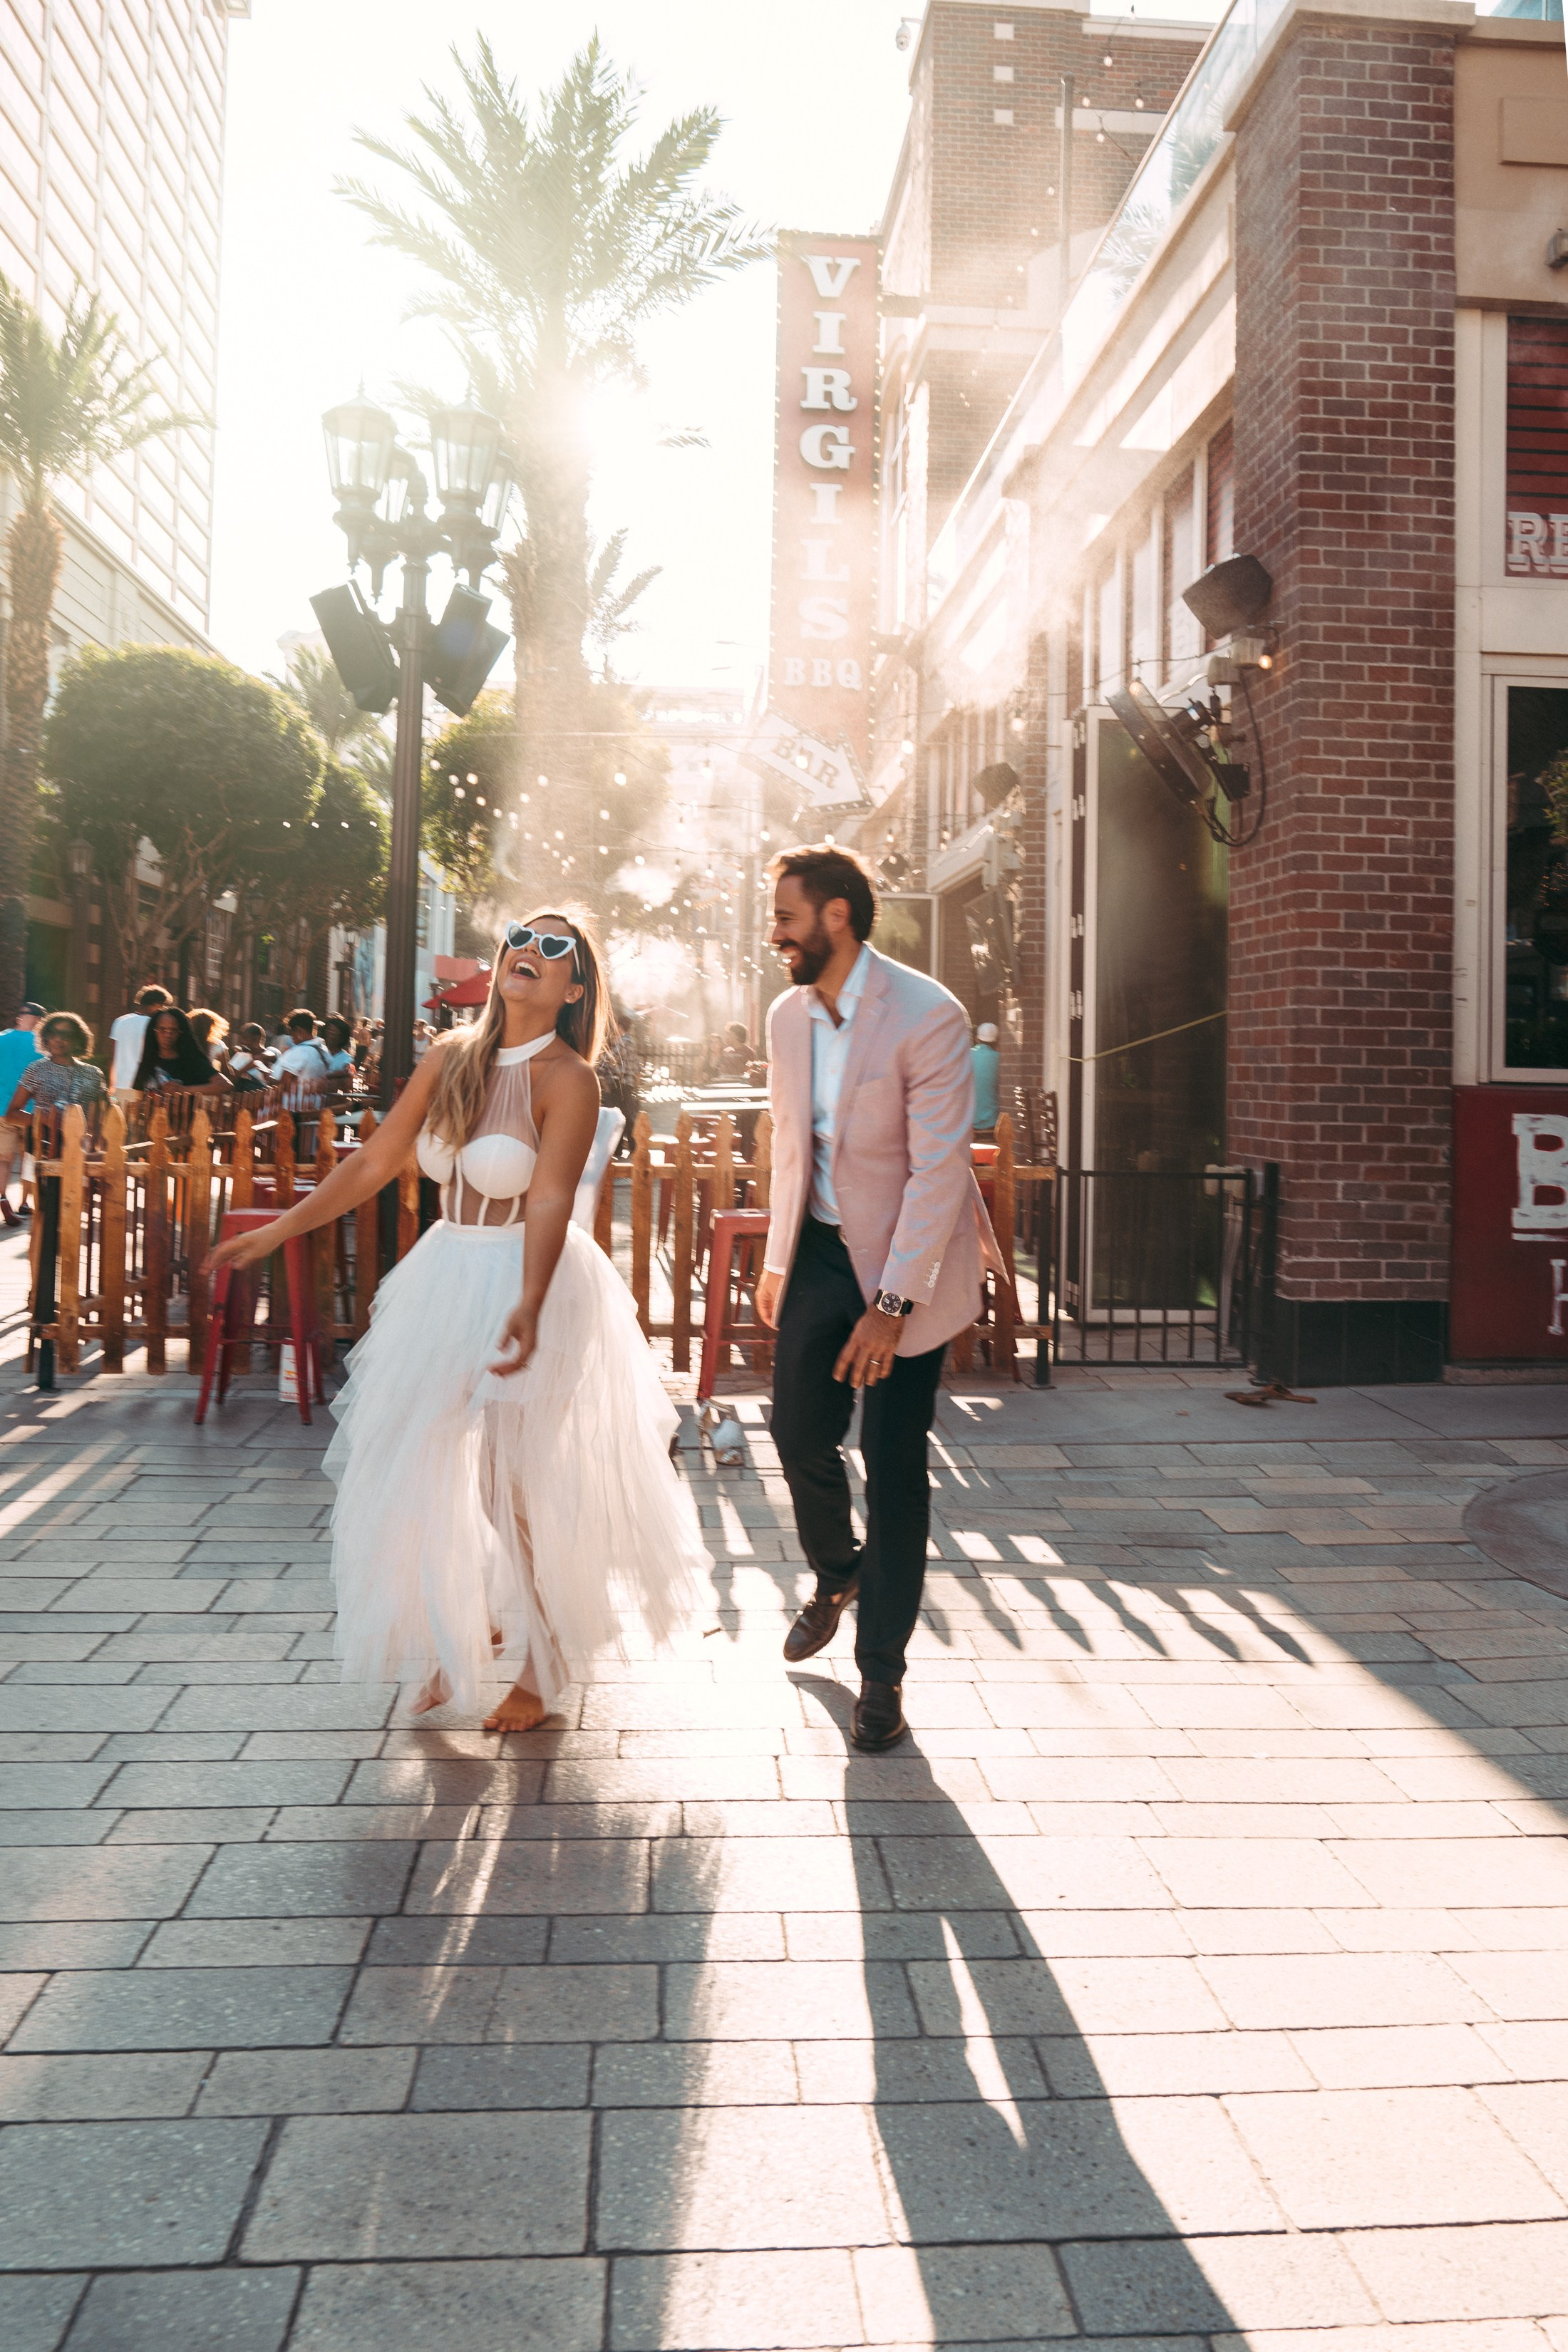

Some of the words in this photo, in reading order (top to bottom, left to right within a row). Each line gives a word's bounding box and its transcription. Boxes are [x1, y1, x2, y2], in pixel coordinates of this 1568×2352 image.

[798, 254, 861, 641] VIRGILS
[783, 657, 862, 691] BBQ
[772, 735, 839, 789] BAR
